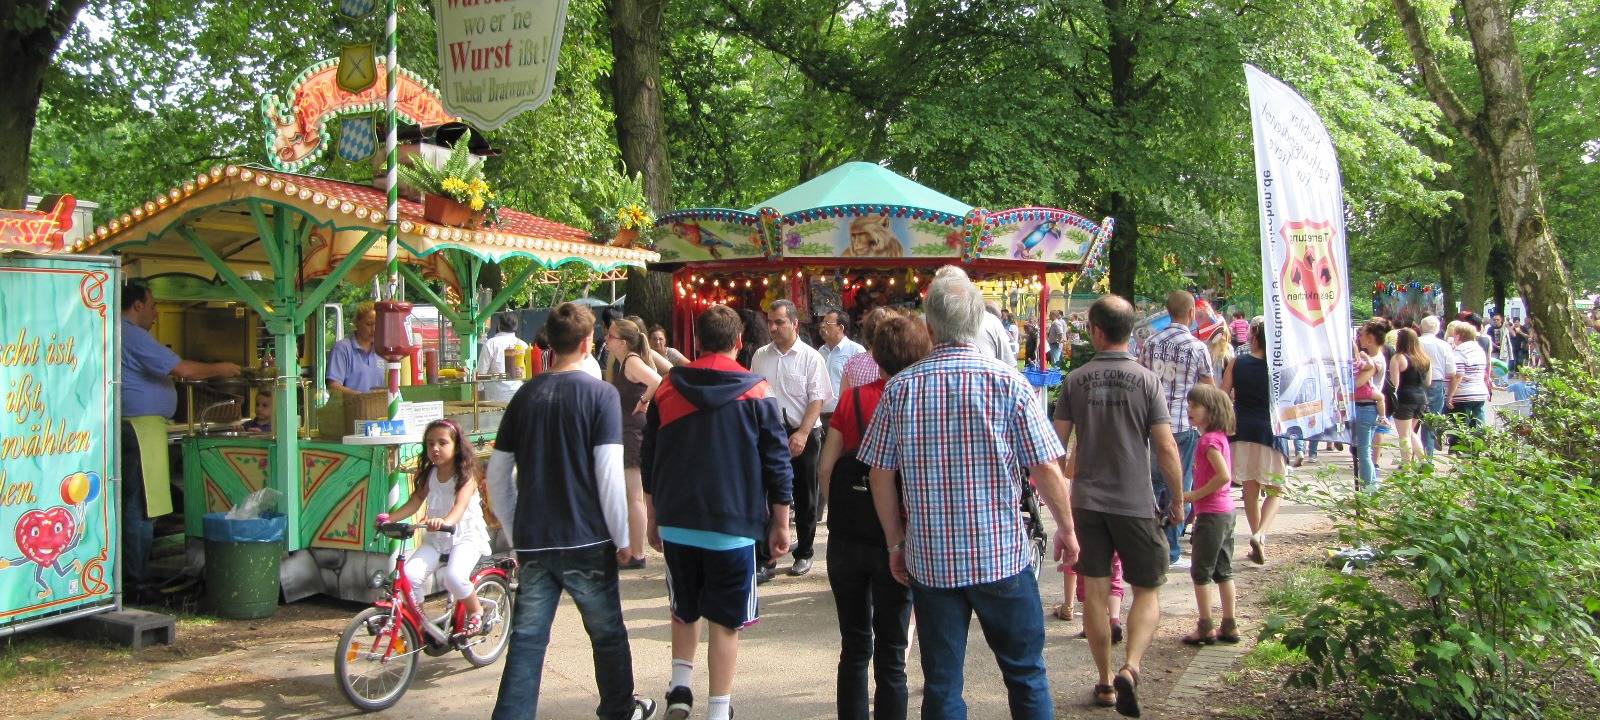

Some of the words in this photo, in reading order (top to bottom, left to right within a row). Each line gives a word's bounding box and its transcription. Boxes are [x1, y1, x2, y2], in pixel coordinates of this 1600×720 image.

[463, 16, 485, 35] wo
[490, 13, 506, 33] er
[448, 38, 513, 74] Wurst
[0, 327, 40, 367] cht
[46, 332, 77, 372] ist,
[1076, 370, 1100, 386] LAKE
[6, 373, 45, 424] ißt,
[1, 417, 90, 460] wählen
